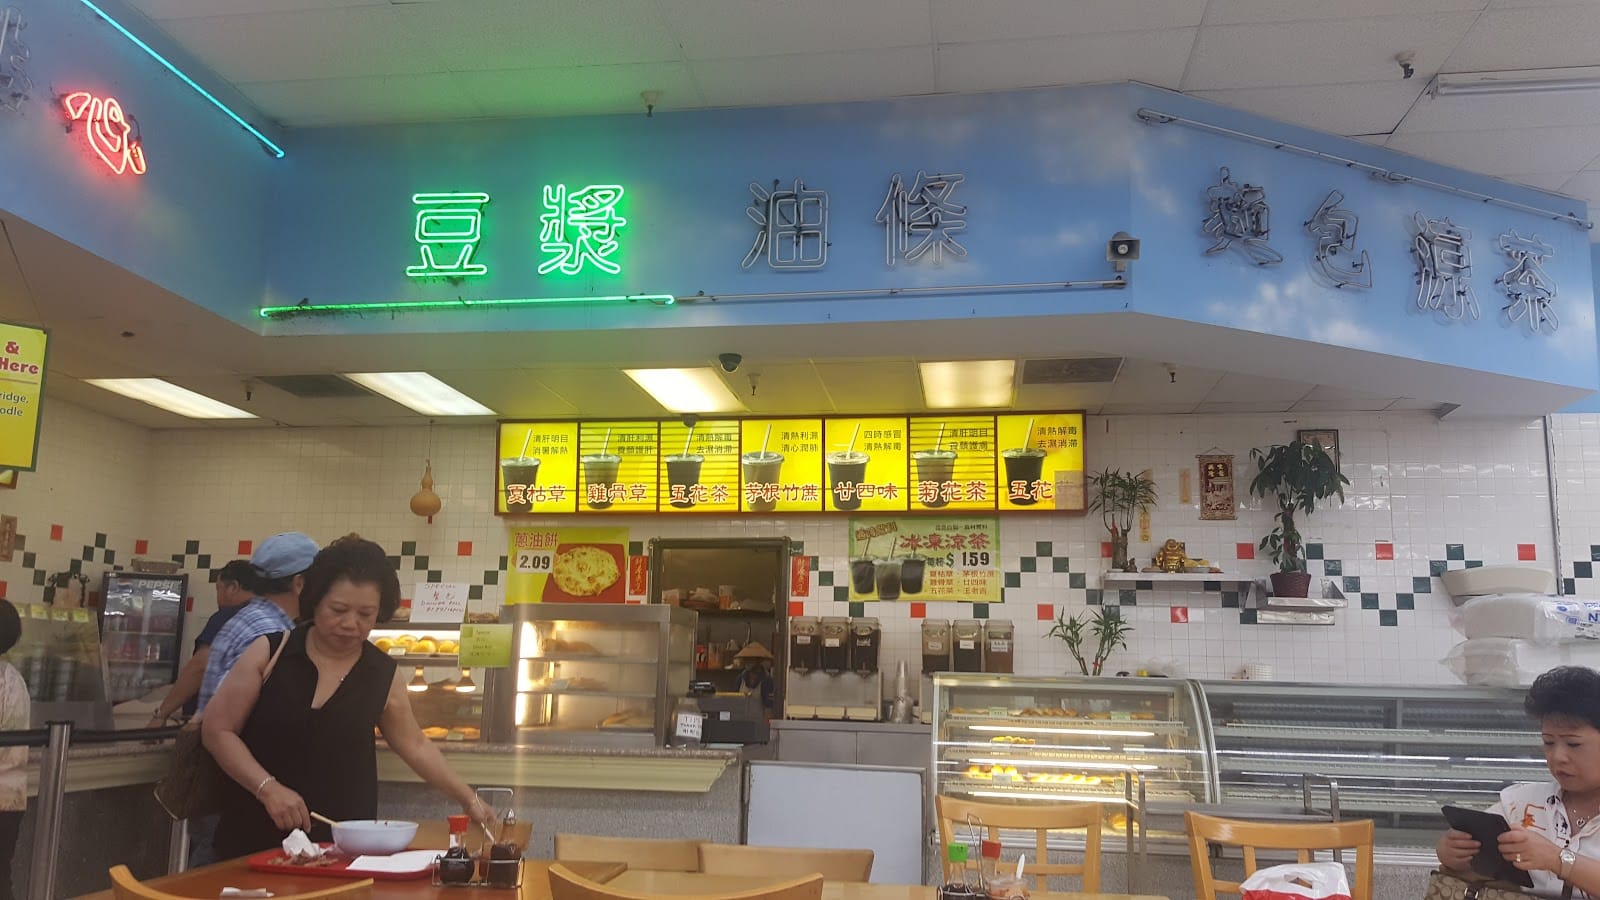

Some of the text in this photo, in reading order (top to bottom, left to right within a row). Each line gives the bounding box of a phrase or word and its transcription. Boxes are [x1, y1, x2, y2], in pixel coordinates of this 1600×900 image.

[405, 170, 968, 277] 豆漿 油條
[5, 341, 19, 355] &
[0, 357, 39, 374] Here
[507, 484, 567, 504] 夏枯草
[588, 483, 647, 503] 雞骨草
[670, 484, 729, 503] 五花茶
[745, 482, 819, 503] 茅根竹蔗
[834, 481, 898, 501] 廿四味
[918, 480, 987, 502] 菊花茶
[1009, 480, 1055, 499] 五花
[519, 555, 551, 570] 2.09
[946, 553, 955, 568] $
[962, 552, 990, 567] 1.59
